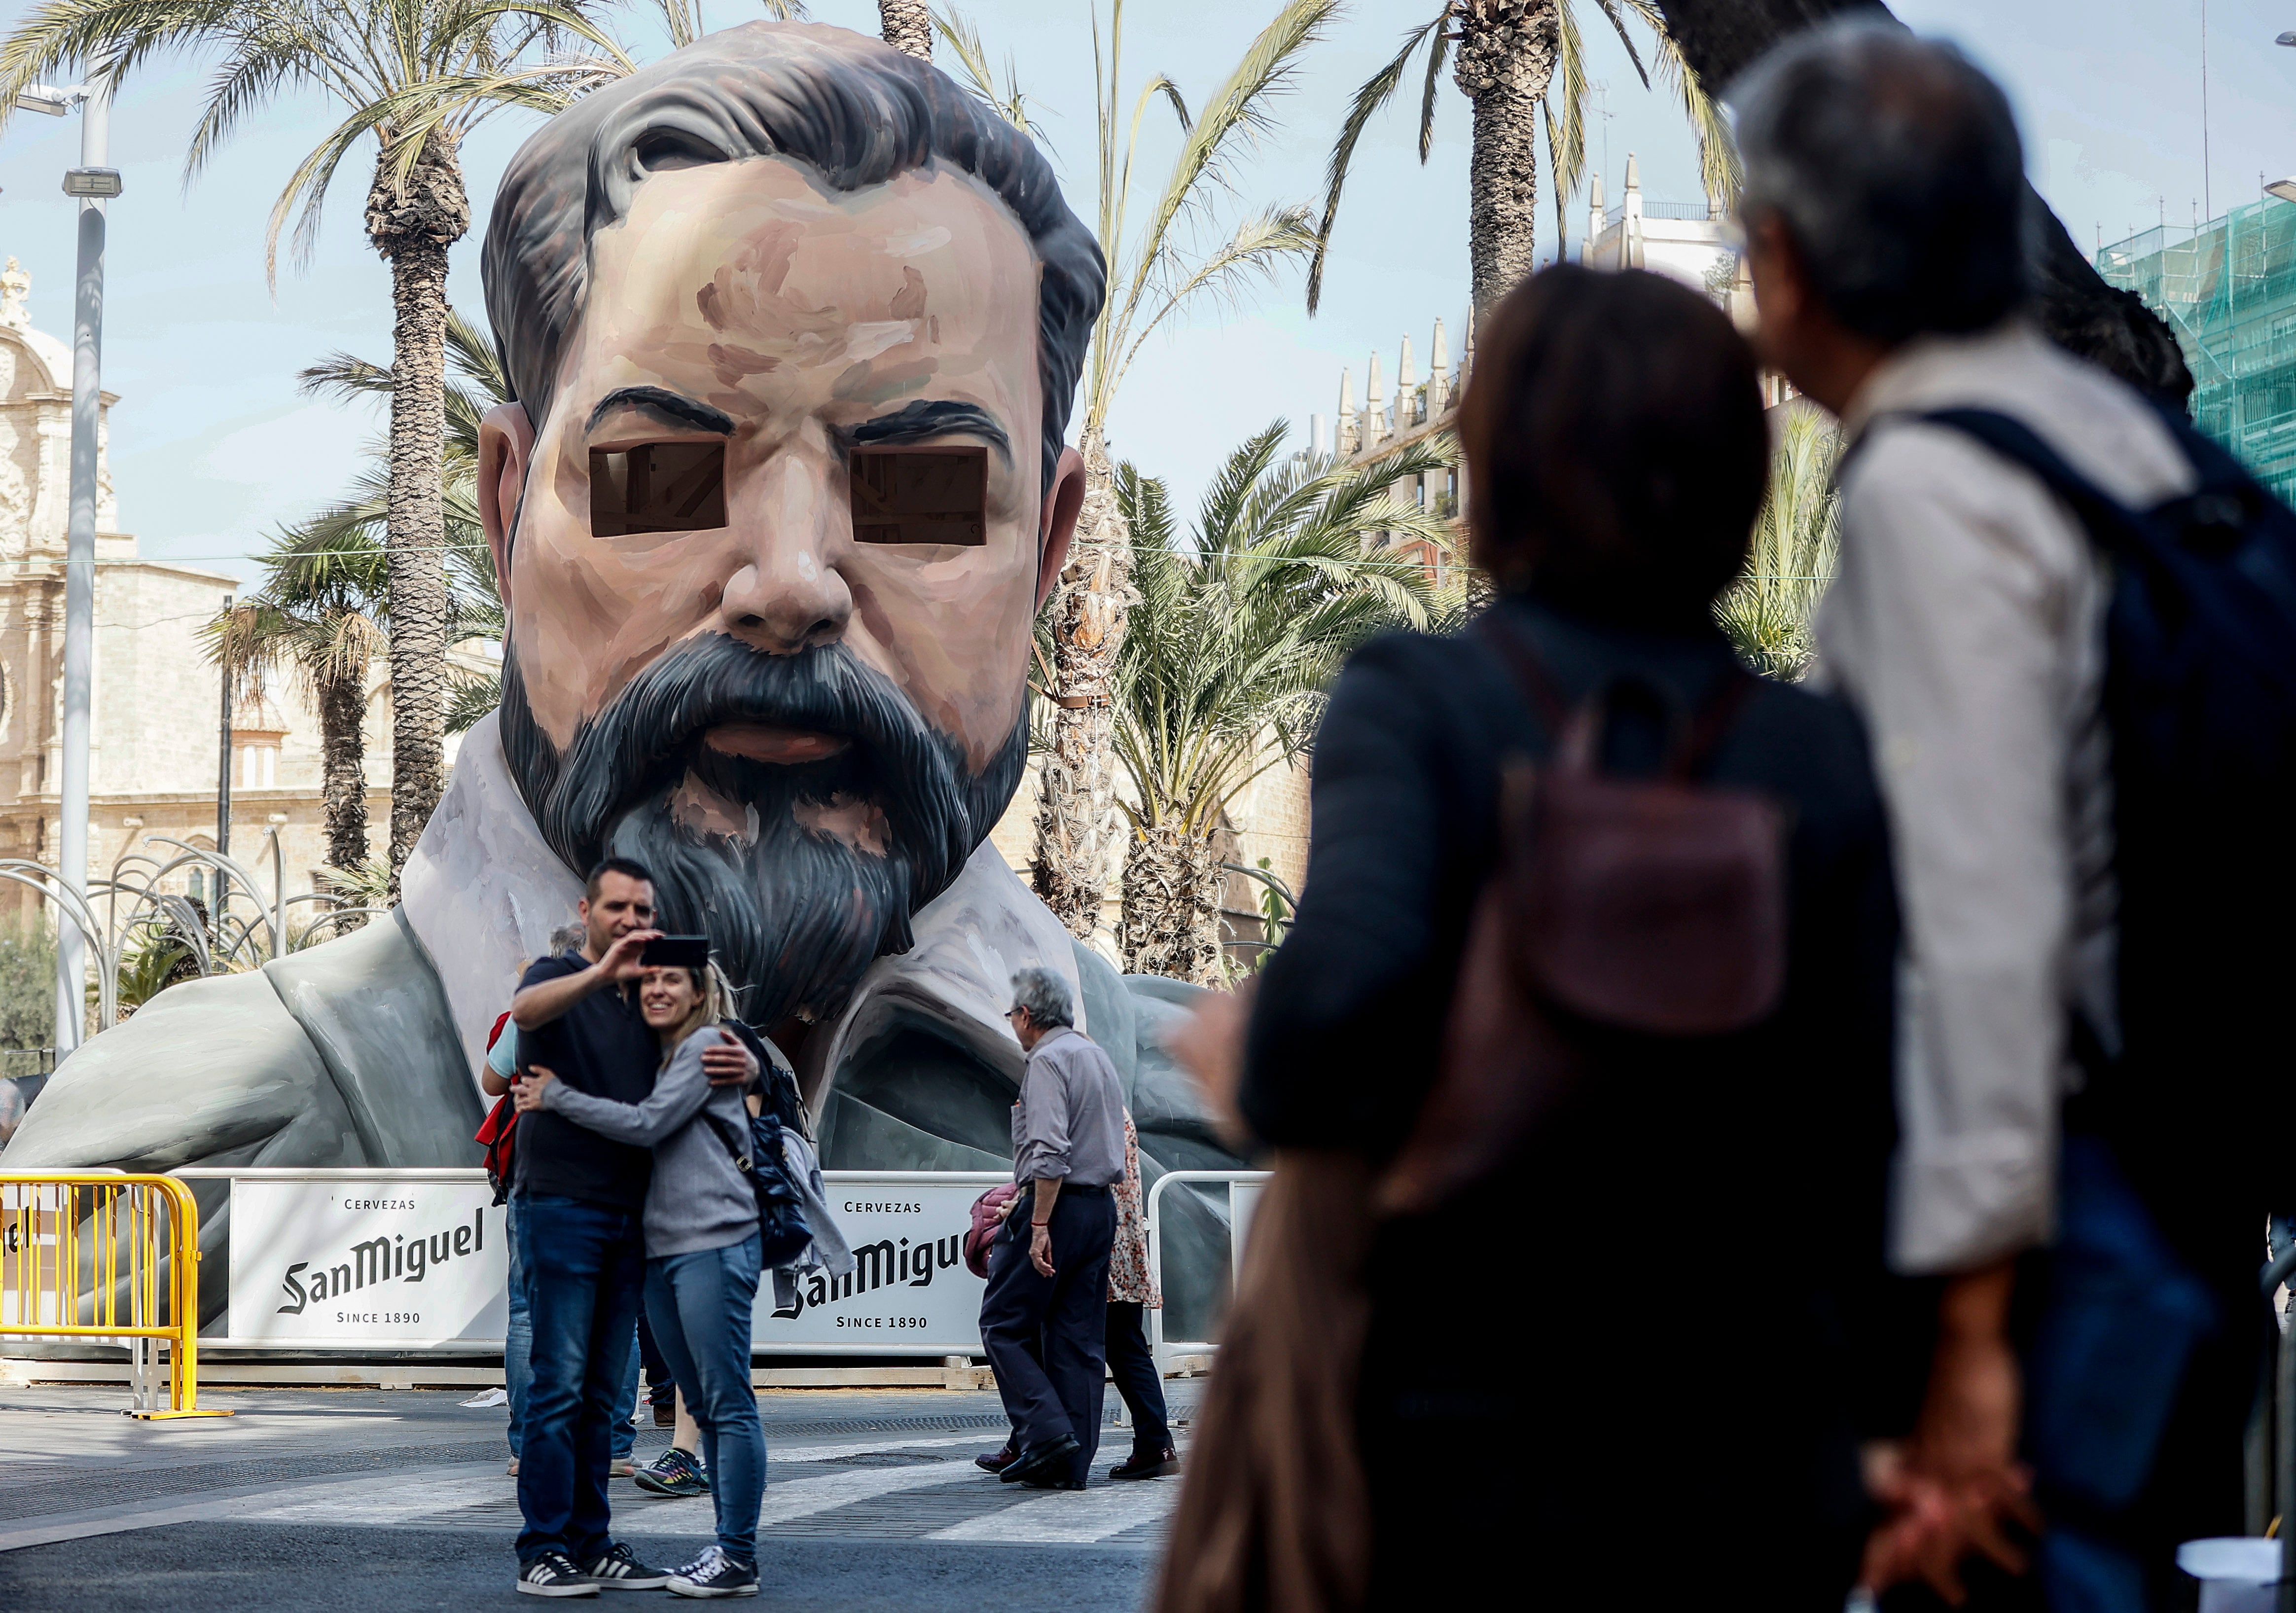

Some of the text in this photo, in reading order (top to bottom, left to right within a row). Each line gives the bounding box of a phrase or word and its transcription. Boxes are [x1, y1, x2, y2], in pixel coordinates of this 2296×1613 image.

[345, 1199, 415, 1210] CERVEZAS
[844, 1201, 921, 1213] CERVEZAS
[337, 1312, 420, 1323] SINCE 1890
[836, 1316, 927, 1328] SINCE 1890
